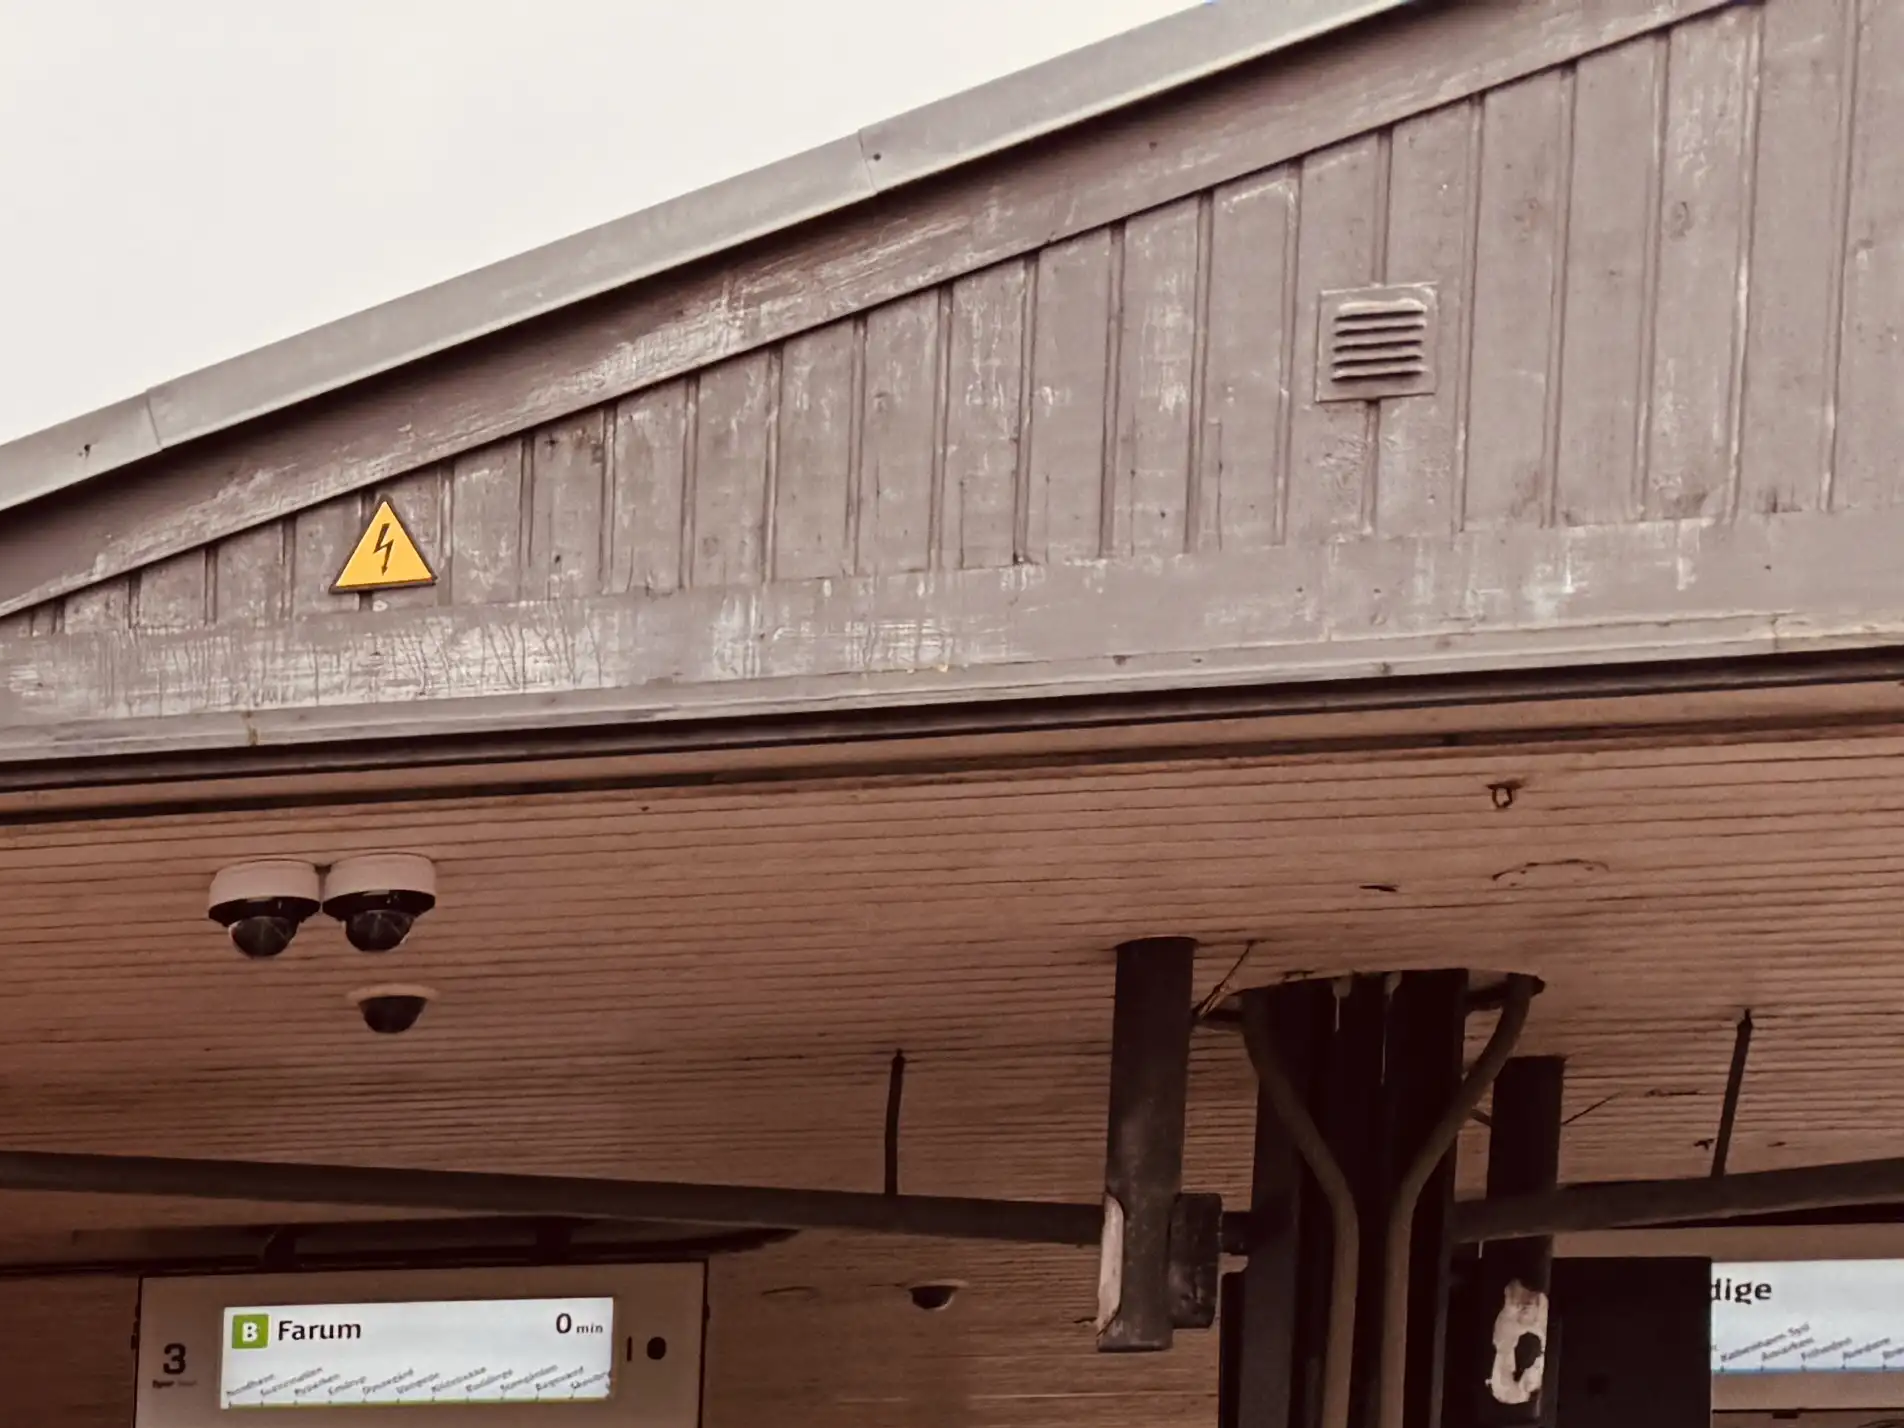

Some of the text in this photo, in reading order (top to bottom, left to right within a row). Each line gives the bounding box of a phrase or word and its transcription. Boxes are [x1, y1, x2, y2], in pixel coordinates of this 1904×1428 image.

[1710, 1278, 1772, 1305] dige
[277, 1320, 362, 1342] Farum
[555, 1312, 604, 1335] 0 min
[163, 1343, 186, 1375] 3
